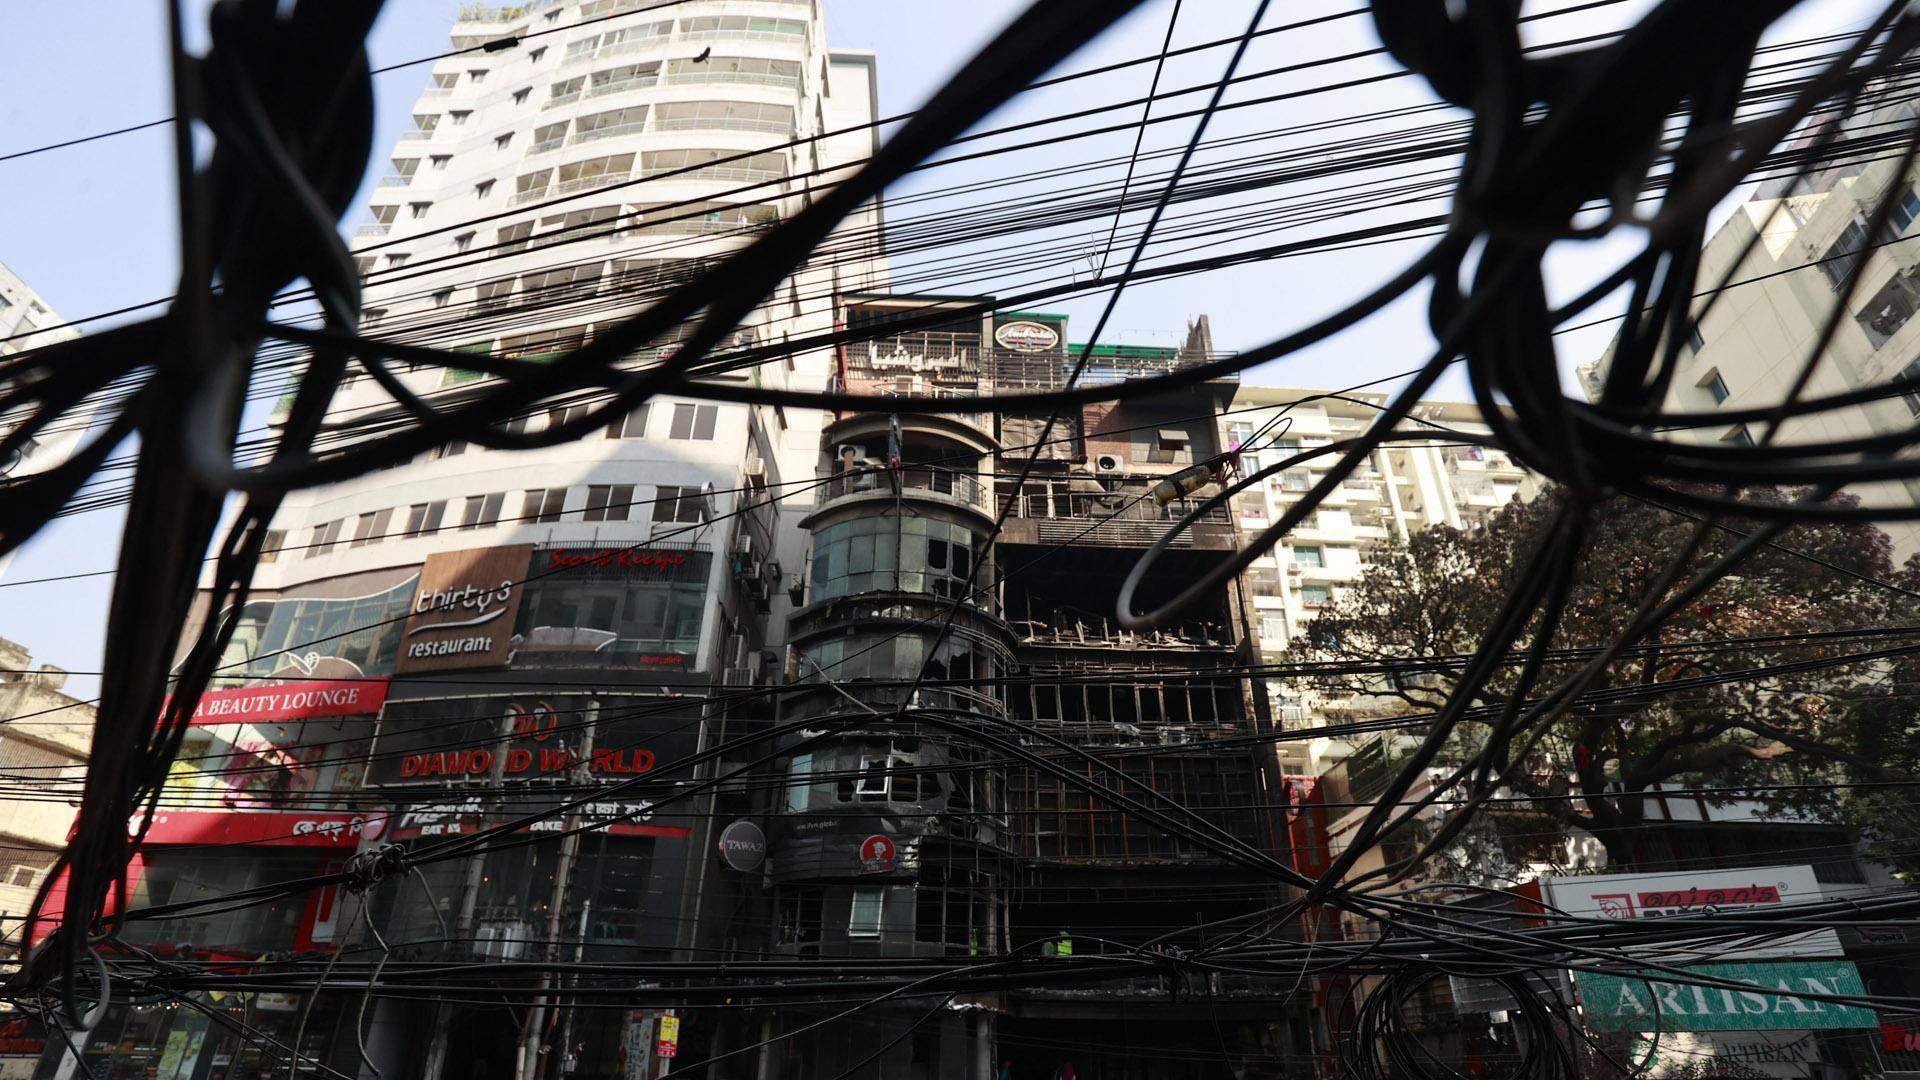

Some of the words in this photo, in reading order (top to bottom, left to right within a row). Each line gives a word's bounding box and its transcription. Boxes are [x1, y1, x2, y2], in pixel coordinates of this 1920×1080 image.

[548, 548, 611, 570] Secret
[613, 548, 687, 573] Recipe
[408, 636, 493, 658] restaurant
[209, 694, 277, 717] BEAUTY
[281, 688, 360, 711] LOUNGE
[540, 747, 655, 774] WRLD
[421, 824, 445, 835] EAT
[1615, 975, 1849, 1016] ARTISAN
